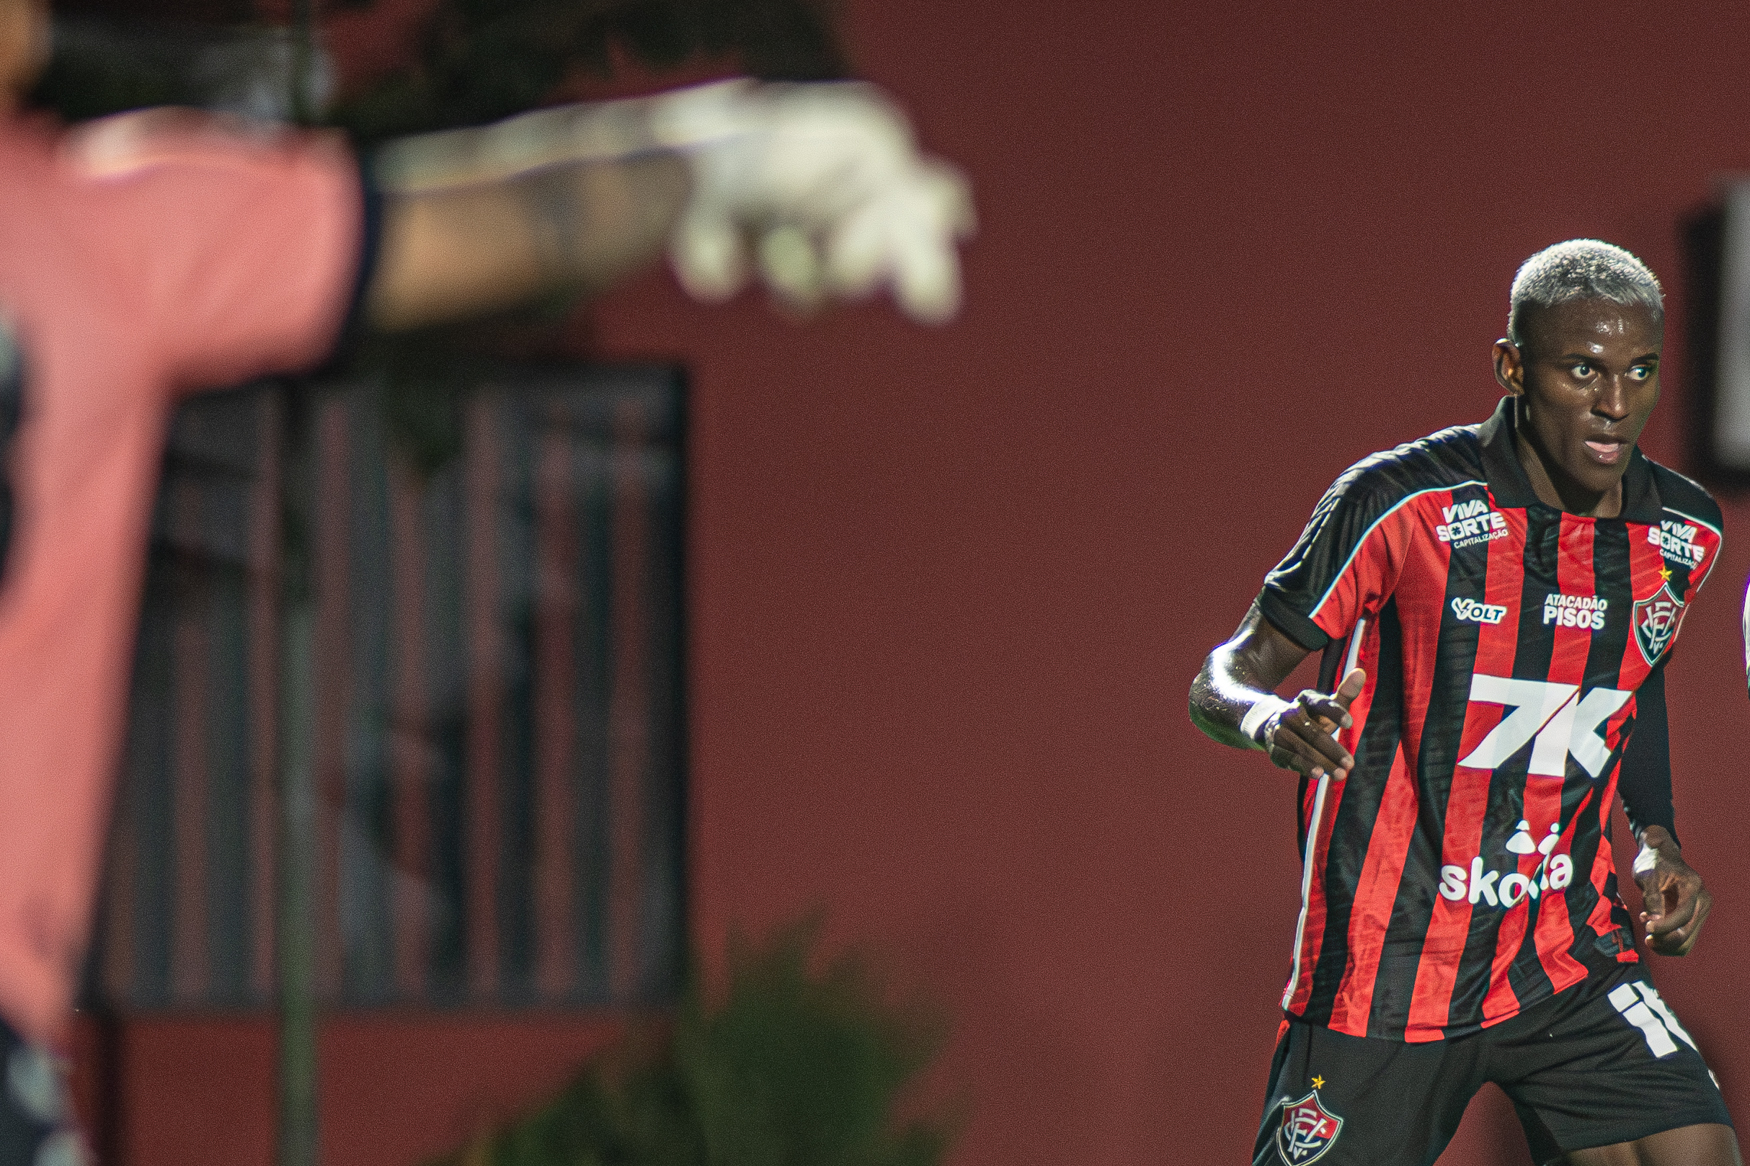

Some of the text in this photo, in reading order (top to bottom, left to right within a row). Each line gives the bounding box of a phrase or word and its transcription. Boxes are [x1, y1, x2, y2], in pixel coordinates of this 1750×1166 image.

[1442, 500, 1488, 524] VIVA
[1436, 512, 1506, 542] SORTE
[1453, 529, 1509, 549] CAPITALIZAÇÃO
[1660, 520, 1698, 543] VIVA
[1647, 526, 1705, 563] SORTE
[1451, 597, 1507, 624] VOLT
[1545, 593, 1608, 611] ATACADÃO
[1543, 606, 1605, 630] PISOS
[1457, 674, 1633, 778] 7K
